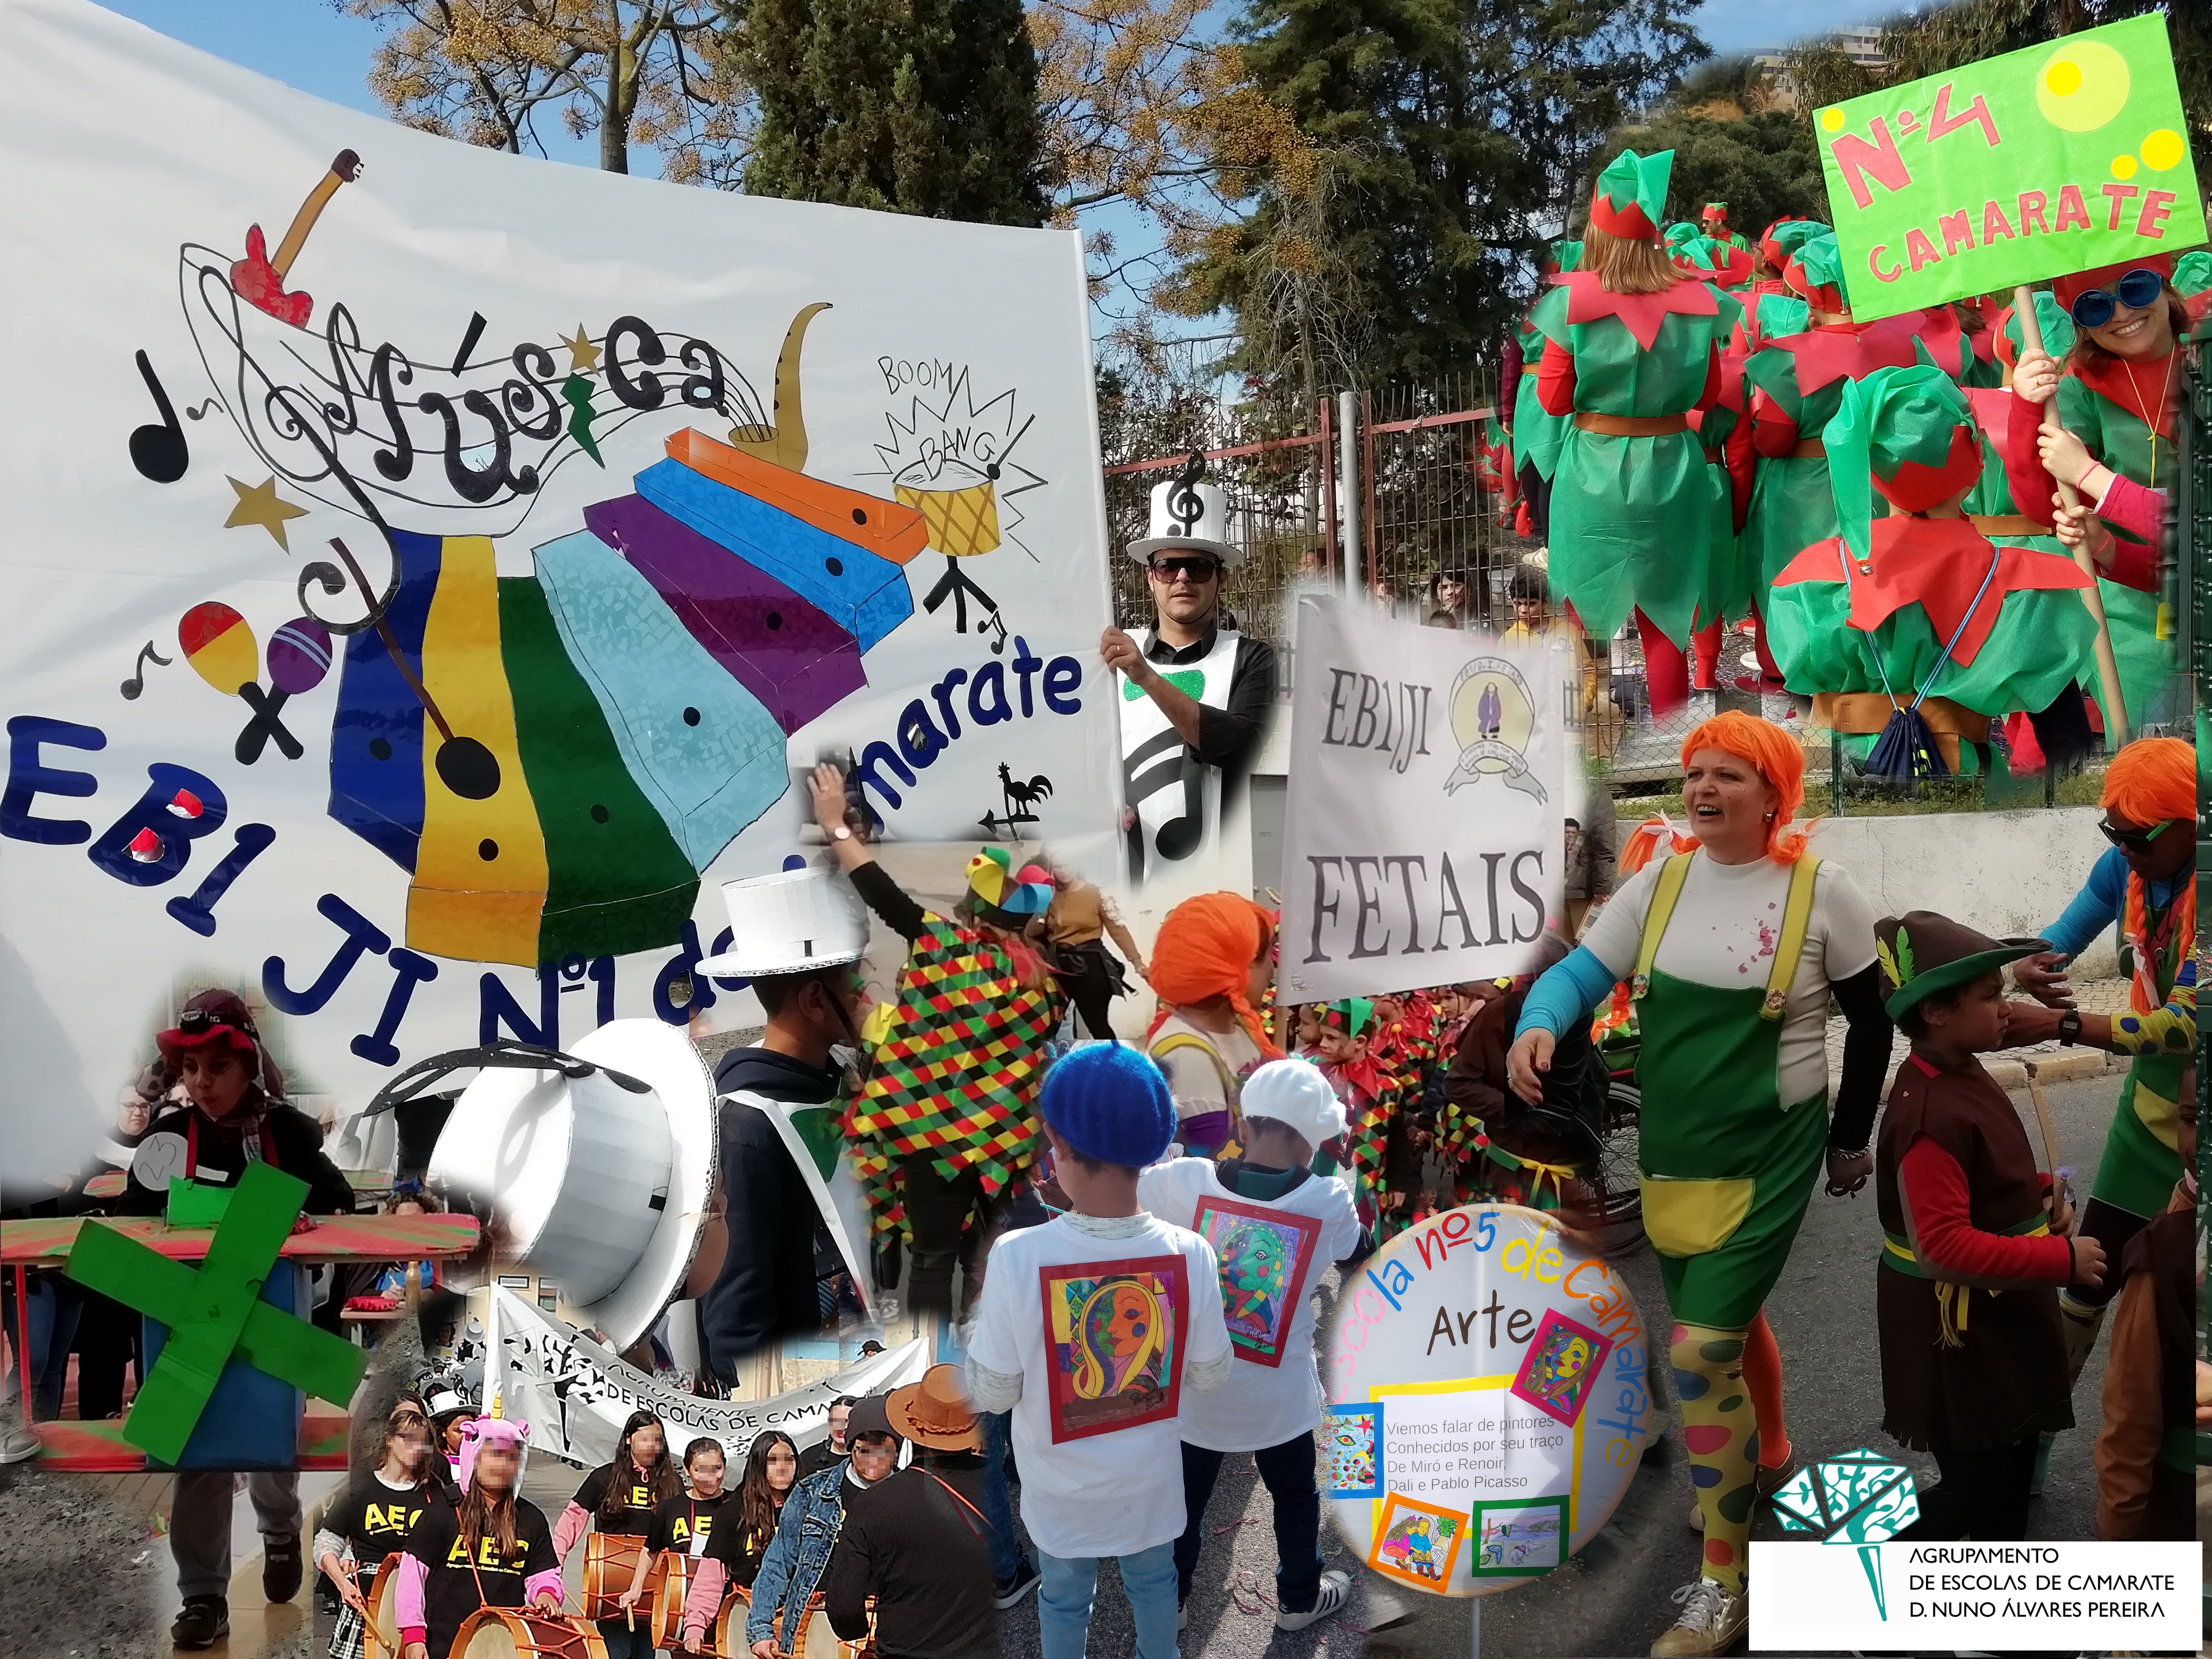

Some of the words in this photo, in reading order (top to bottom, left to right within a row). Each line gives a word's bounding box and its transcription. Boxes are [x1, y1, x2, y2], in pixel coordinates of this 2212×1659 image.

[1869, 183, 2177, 283] CAMARATE
[878, 356, 952, 395] BOOM
[919, 426, 996, 481] BANG
[1303, 851, 1545, 964] FETAIS
[262, 893, 439, 1067] JI
[1501, 1220, 1563, 1284] de
[1426, 1289, 1536, 1355] Arte
[608, 1385, 631, 1405] DE
[636, 1395, 719, 1431] ESCOLAS
[729, 1415, 759, 1430] DE
[766, 1402, 831, 1424] CAMA
[1386, 1422, 1438, 1435] Viemos
[1443, 1419, 1473, 1433] falar
[1478, 1418, 1495, 1432] de
[1499, 1417, 1555, 1434] pintores
[1387, 1440, 1469, 1454] Conhecidos
[1473, 1440, 1496, 1454] por
[1500, 1439, 1525, 1450] seu
[1530, 1435, 1563, 1450] traço
[1387, 1461, 1406, 1472] De
[1411, 1459, 1440, 1472] Miró
[1445, 1461, 1453, 1471] e
[1458, 1457, 1506, 1471] Renoir,
[1388, 1479, 1413, 1491] Dali
[1418, 1481, 1426, 1491] e
[1431, 1477, 1469, 1489] Pablo
[1474, 1475, 1528, 1488] Picasso
[673, 1516, 713, 1540] AE
